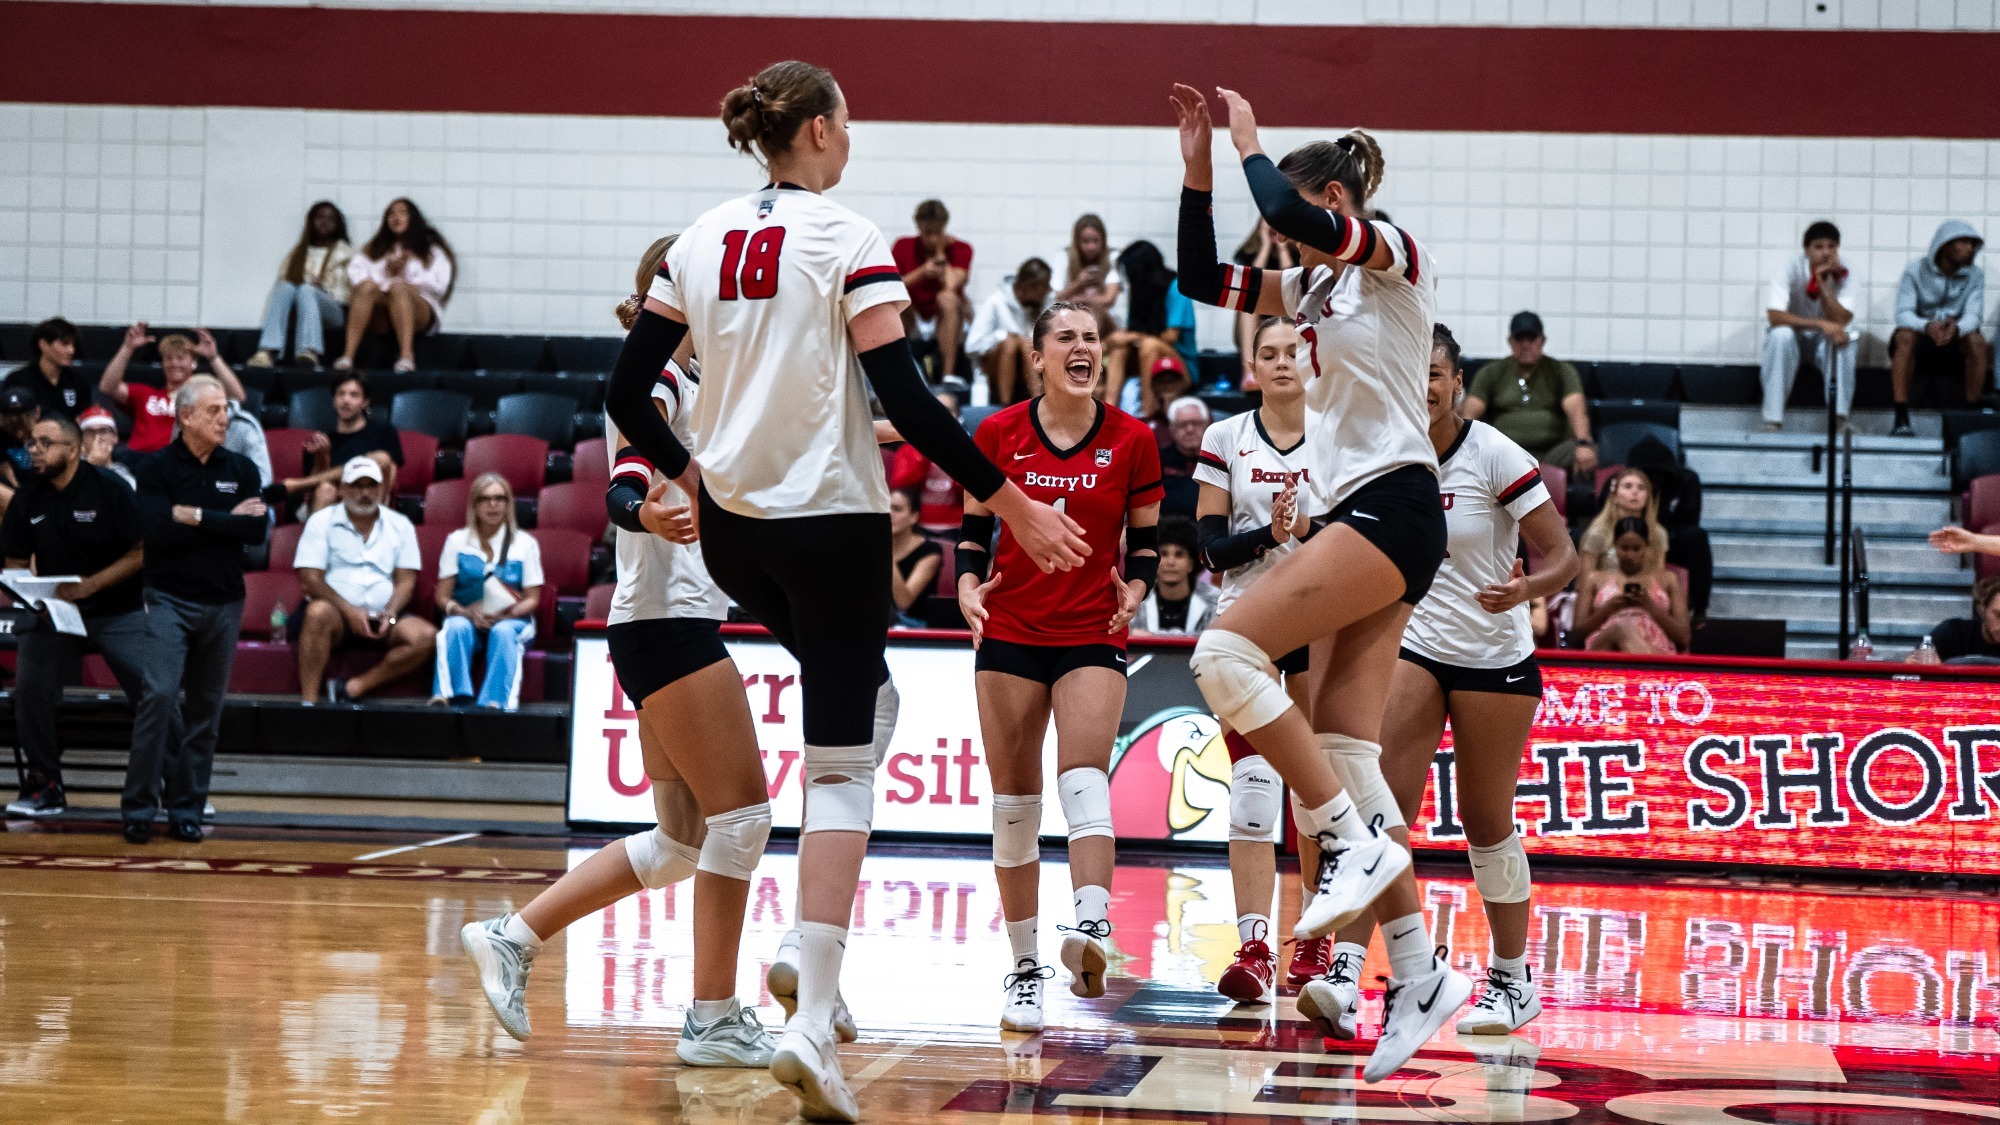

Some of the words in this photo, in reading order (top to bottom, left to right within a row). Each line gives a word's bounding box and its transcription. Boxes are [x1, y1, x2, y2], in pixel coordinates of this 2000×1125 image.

[719, 226, 786, 301] 18
[1300, 326, 1321, 379] 7
[1025, 471, 1079, 492] Barry
[1081, 474, 1098, 489] U
[1639, 681, 1713, 724] TO
